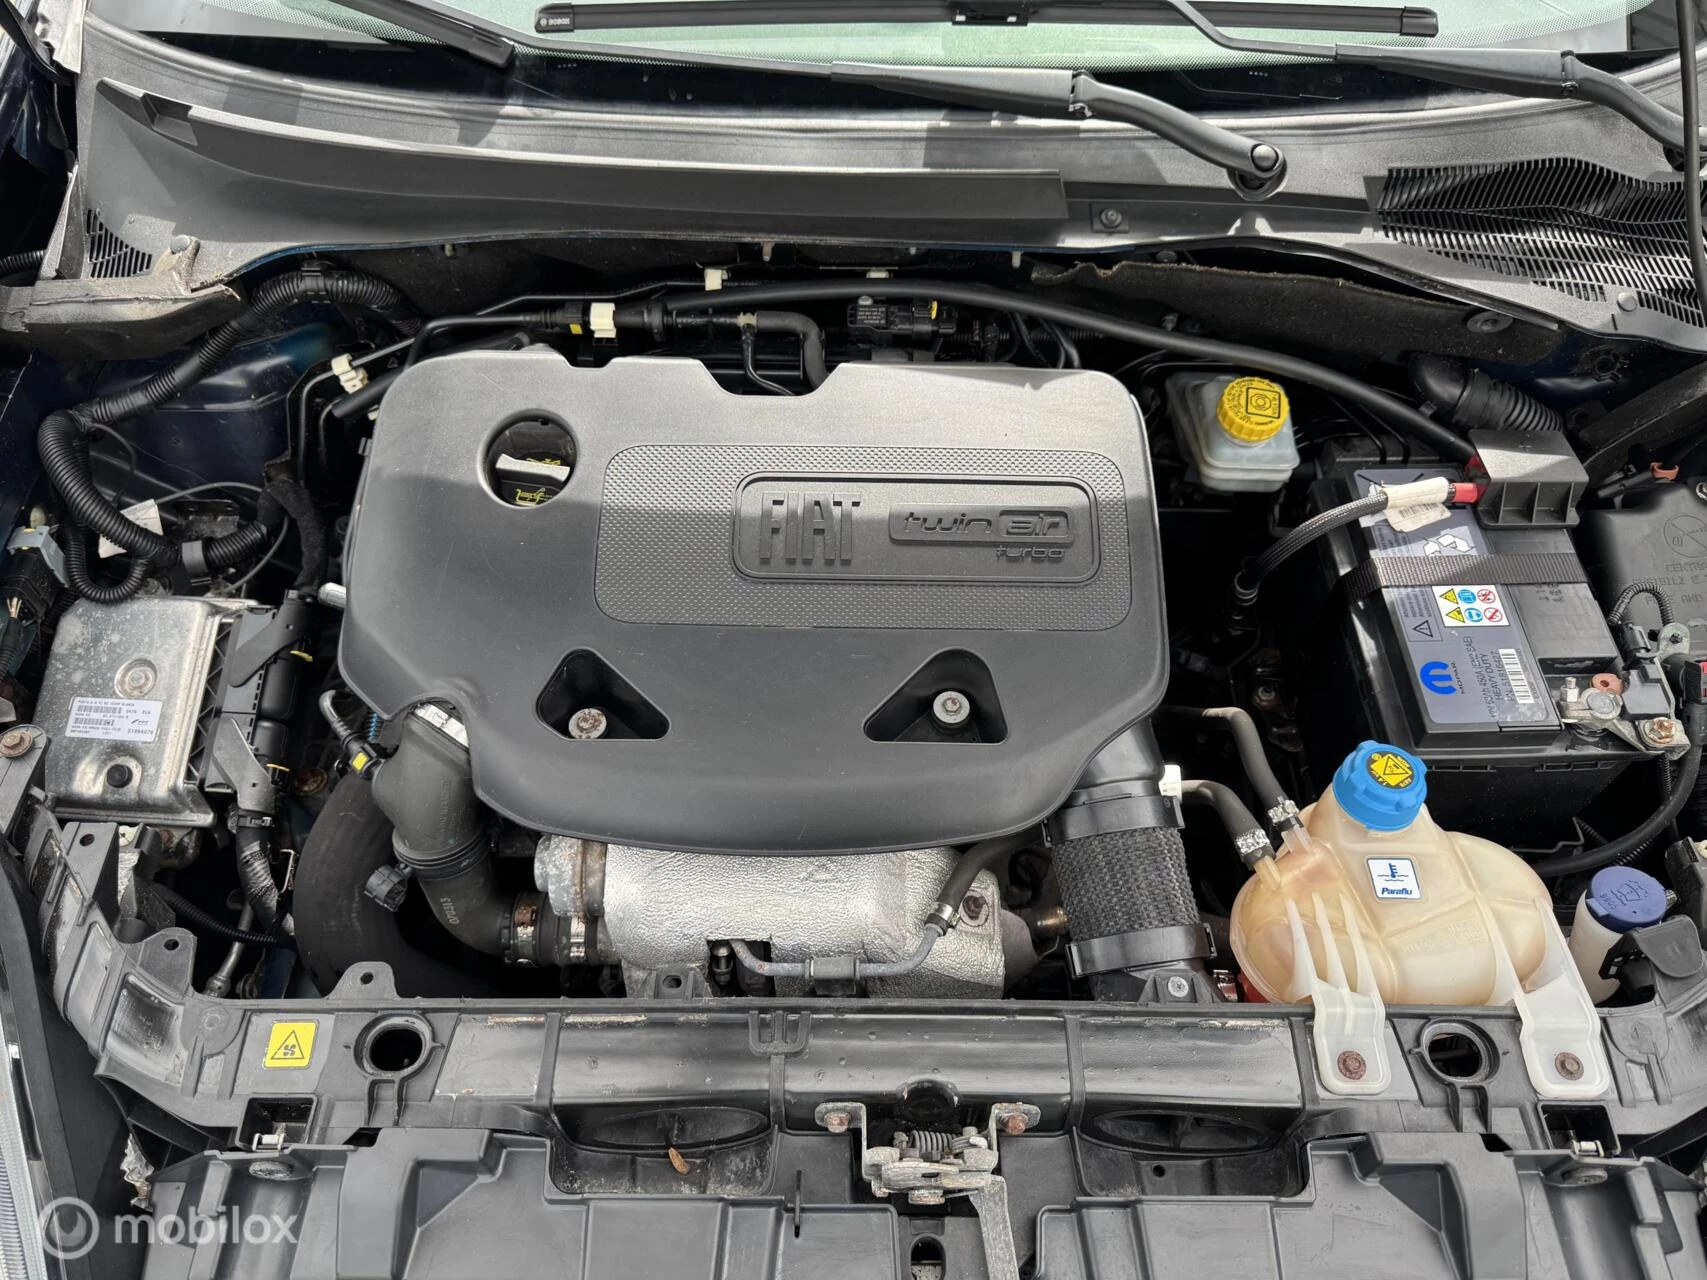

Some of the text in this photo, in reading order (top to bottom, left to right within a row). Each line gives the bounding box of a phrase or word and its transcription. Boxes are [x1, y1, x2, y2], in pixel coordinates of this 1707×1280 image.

[760, 492, 861, 564] FIAT
[903, 511, 1062, 537] twin air
[996, 546, 1066, 562] turbo
[1478, 652, 1504, 700] HEAVY DUTY
[1381, 887, 1413, 896] Paraflu
